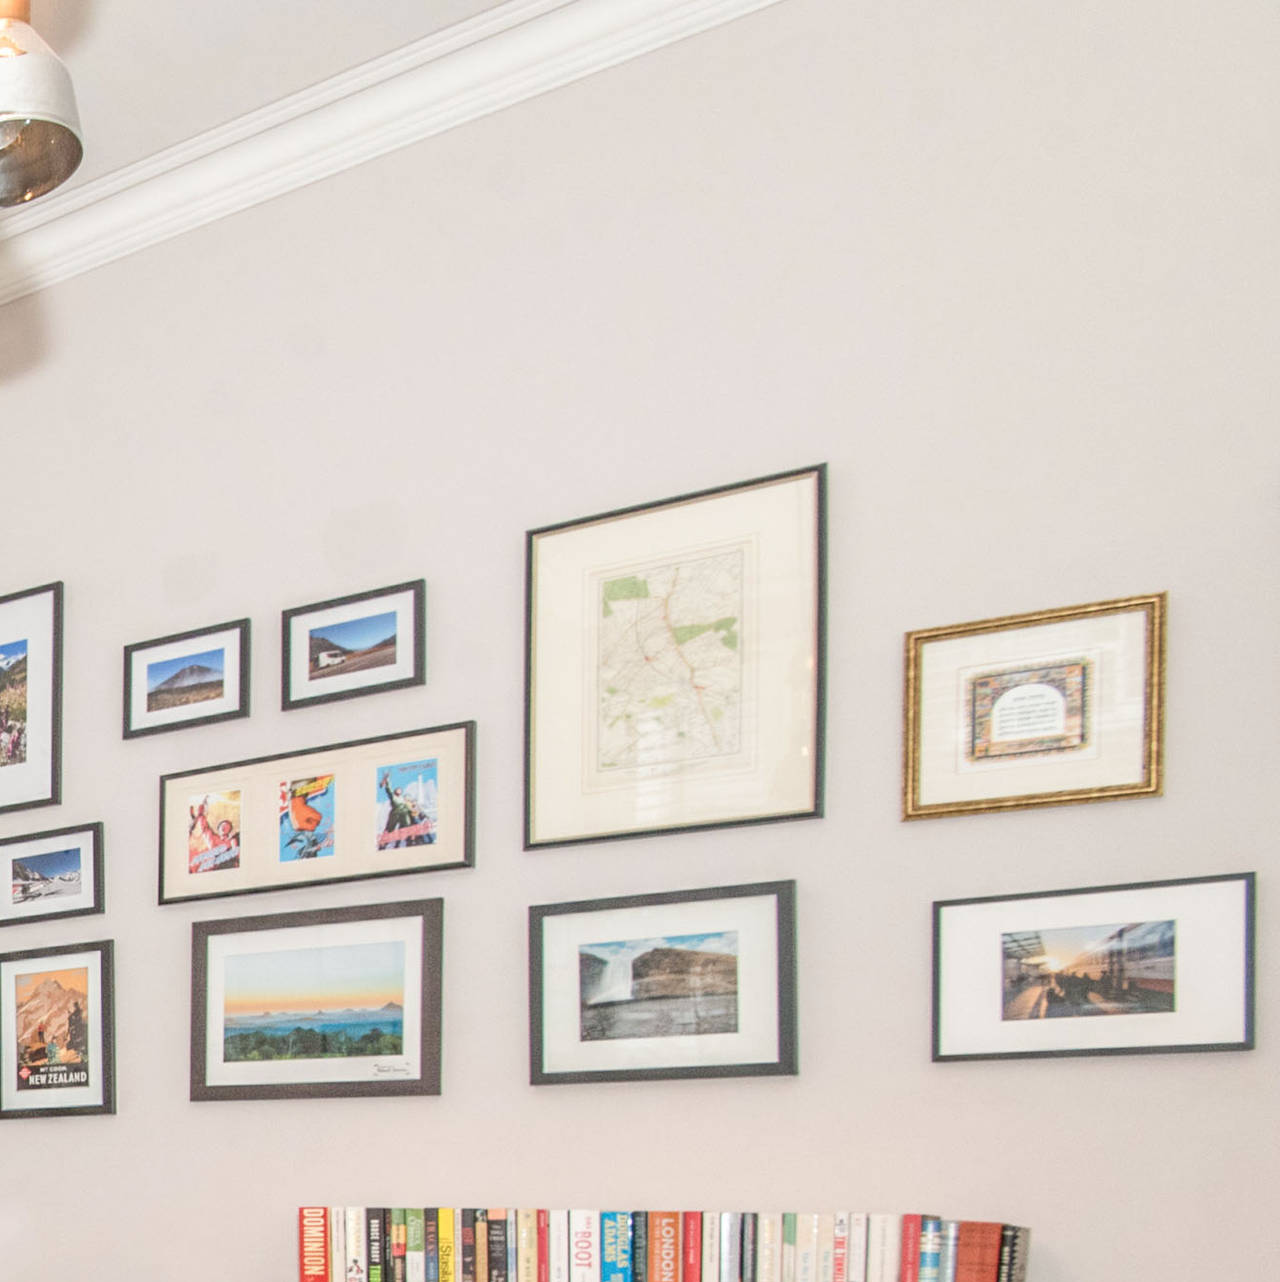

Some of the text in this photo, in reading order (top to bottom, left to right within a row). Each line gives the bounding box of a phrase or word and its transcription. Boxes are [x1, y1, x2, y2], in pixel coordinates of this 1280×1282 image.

[29, 1072, 87, 1085] NEW ZEALAND
[303, 1208, 325, 1275] DOMINION
[369, 1219, 380, 1239] BRUCE
[604, 1219, 616, 1262] ADAMS
[616, 1214, 629, 1268] DOUGLAS
[834, 1236, 847, 1251] THE
[370, 1242, 380, 1262] PARRY
[574, 1231, 592, 1269] BOOT
[662, 1218, 674, 1282] LONDON
